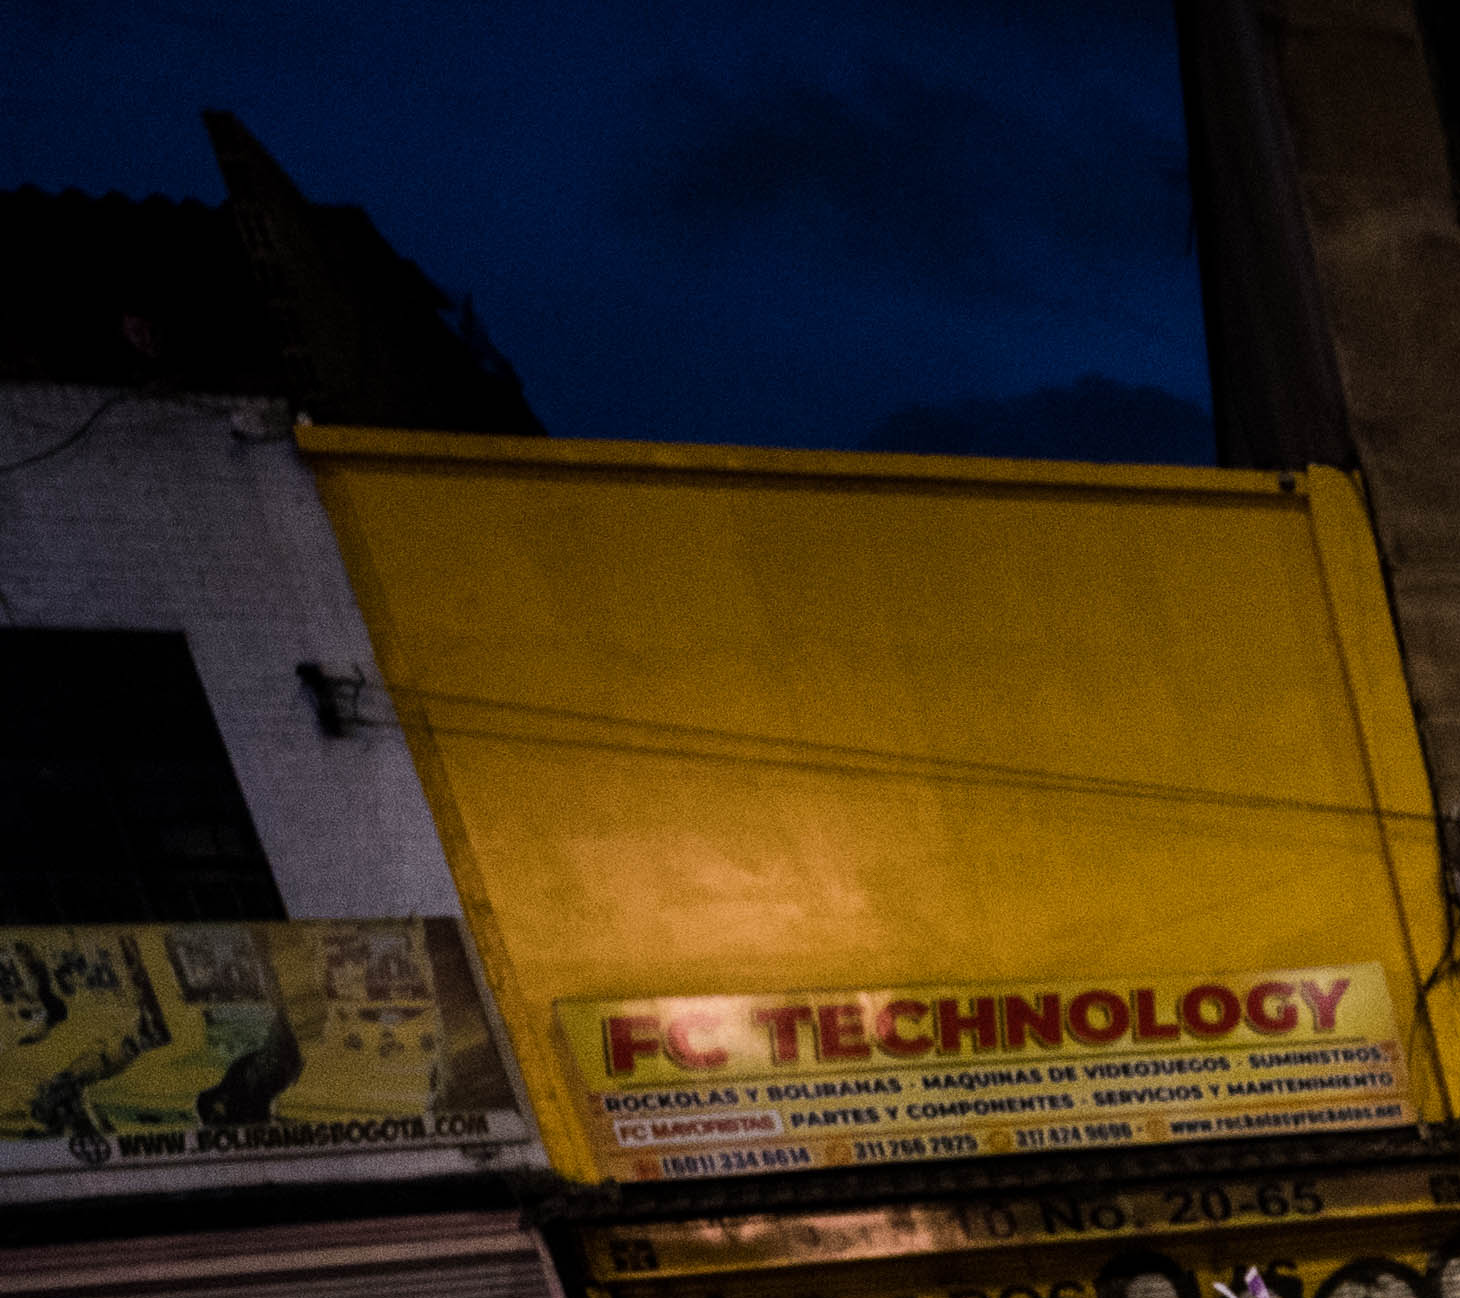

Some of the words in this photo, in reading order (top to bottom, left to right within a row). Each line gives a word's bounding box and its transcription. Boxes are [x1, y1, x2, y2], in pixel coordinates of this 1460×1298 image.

[606, 1010, 729, 1078] FC
[754, 976, 1351, 1067] TECHNOLOGY
[605, 1089, 739, 1114] ROCKOLAS
[746, 1088, 761, 1104] Y
[766, 1077, 902, 1102] BOLIRANAS
[922, 1068, 1043, 1092] MAQUINAS
[1049, 1064, 1077, 1083] DE
[1083, 1056, 1231, 1080] VIDEOJUEGOS
[791, 1108, 880, 1129] PARTES
[888, 1106, 900, 1122] Y
[906, 1093, 1075, 1122] COMPONENTES
[1092, 1085, 1204, 1109] SERVICIOS
[1209, 1084, 1221, 1099] Y
[1227, 1071, 1394, 1097] MANTENIMIENTO
[1042, 1196, 1145, 1236] No.
[1166, 1180, 1325, 1225] 20-65
